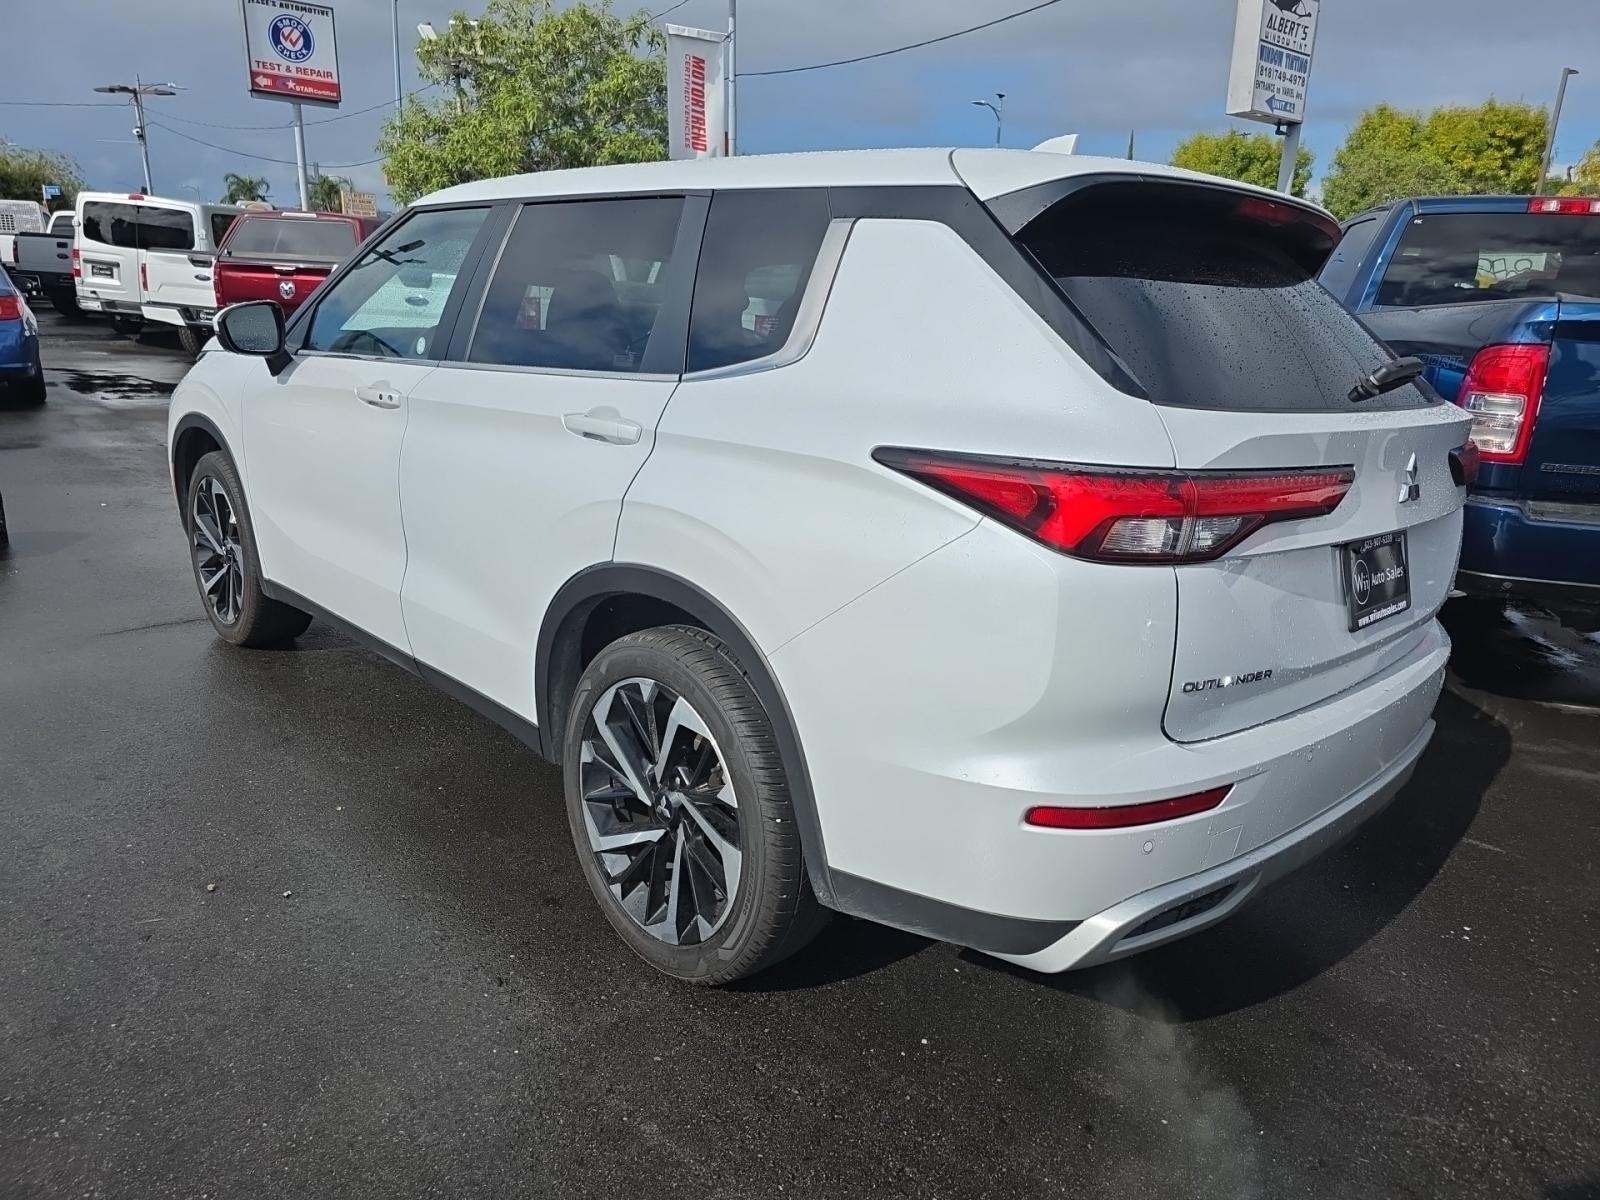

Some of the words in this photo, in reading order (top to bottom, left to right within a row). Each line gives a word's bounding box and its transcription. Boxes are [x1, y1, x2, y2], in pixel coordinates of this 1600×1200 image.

[279, 2, 330, 17] AUTOMOTIVE
[277, 18, 304, 32] SMOG
[1266, 13, 1309, 40] ALBERT'S
[1264, 31, 1290, 46] WINDOW
[277, 44, 308, 58] CHECK
[255, 60, 282, 71] TEST
[285, 65, 292, 73] &
[295, 67, 333, 79] REPAIR
[691, 55, 707, 152] MOTORTREND
[1371, 571, 1385, 587] Auto
[1386, 564, 1404, 581] Sales
[1182, 669, 1273, 693] OUTLNDER
